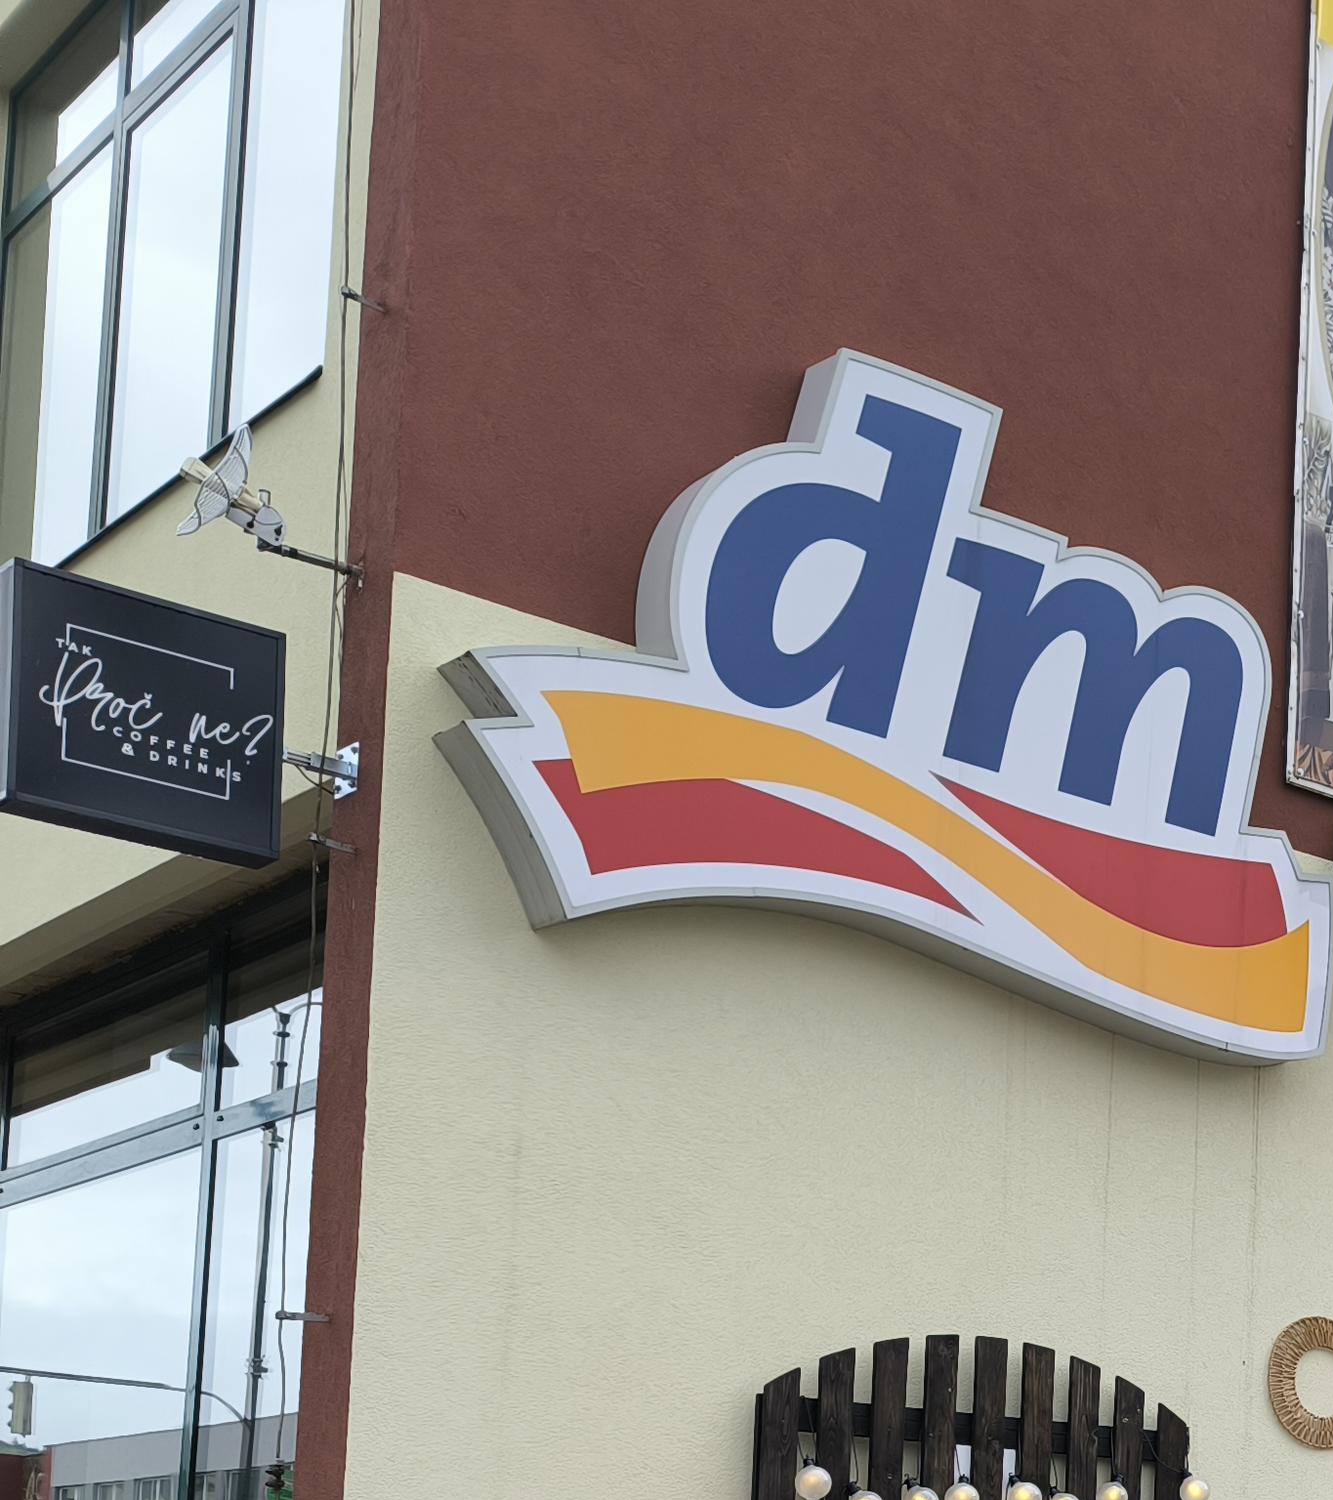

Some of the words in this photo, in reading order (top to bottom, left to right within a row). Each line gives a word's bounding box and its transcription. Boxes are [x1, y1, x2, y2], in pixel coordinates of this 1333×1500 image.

[704, 393, 1245, 837] dm
[55, 637, 93, 657] TAK
[39, 652, 163, 731] Proč
[189, 712, 274, 766] ne?
[112, 726, 209, 760] COFFEE
[120, 742, 136, 757] &
[149, 750, 242, 783] DRINKS
